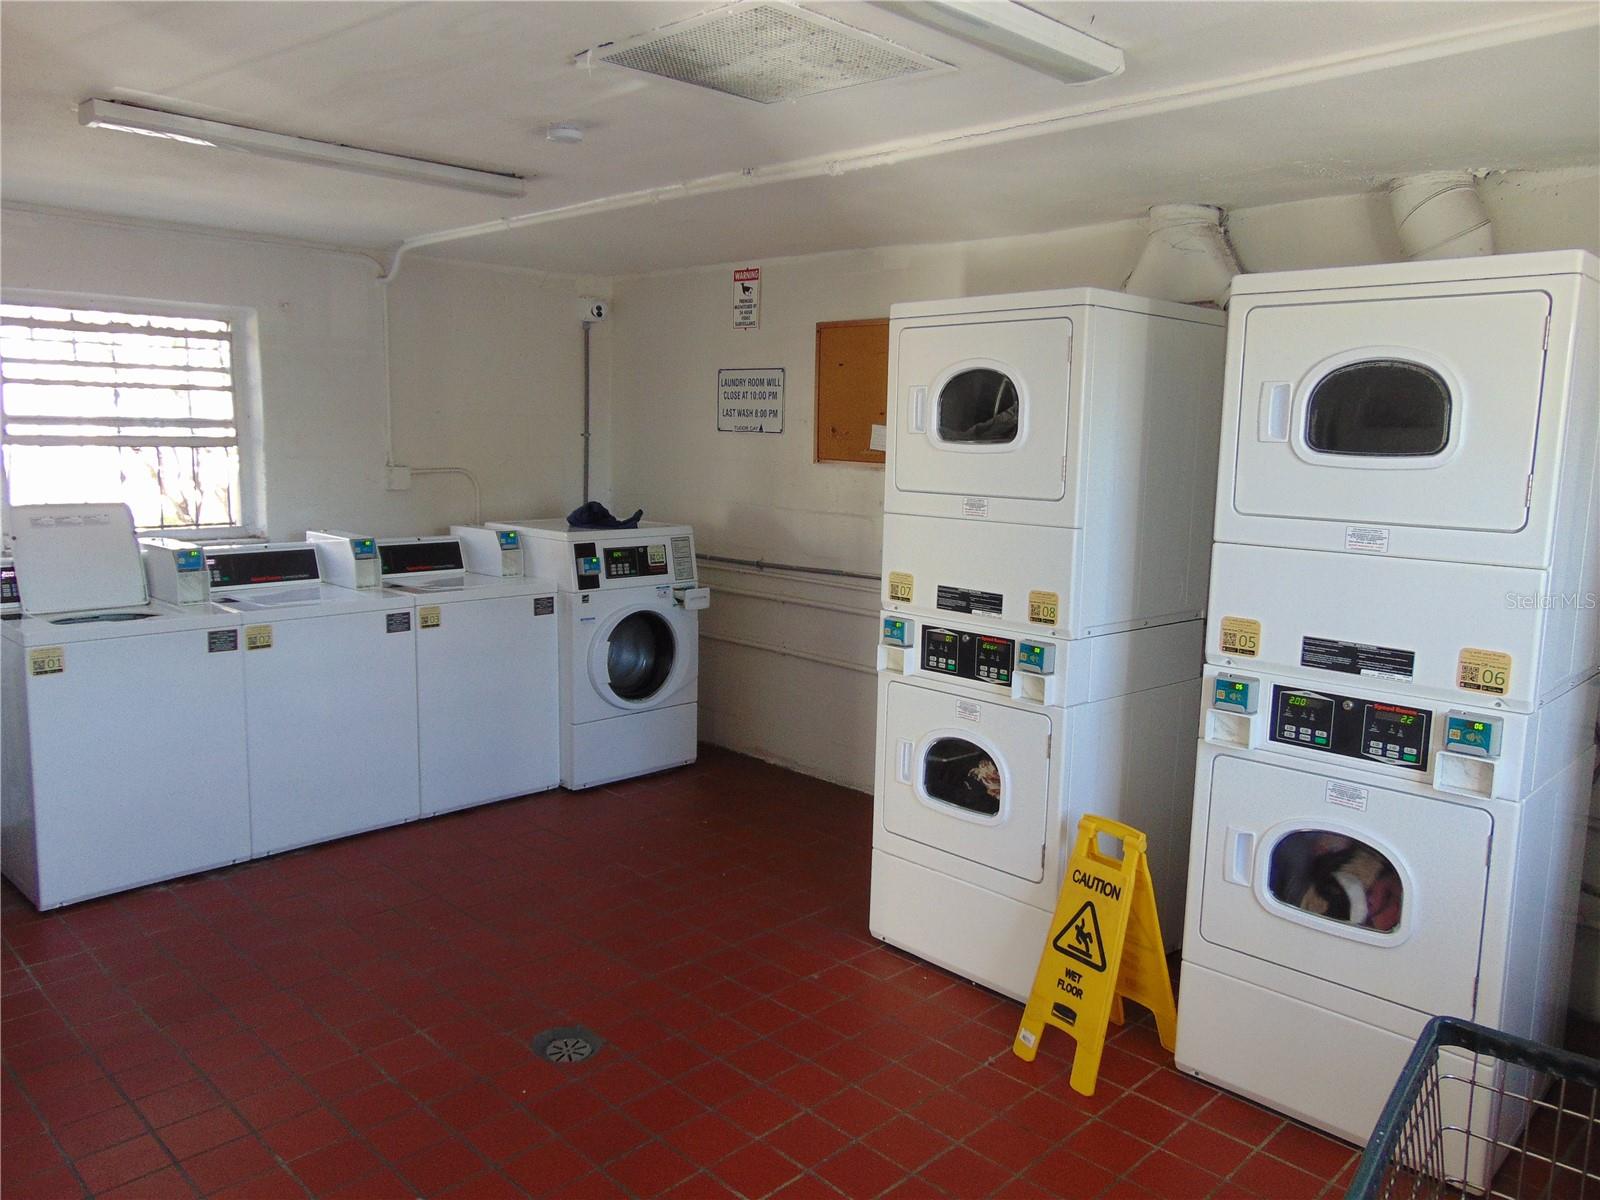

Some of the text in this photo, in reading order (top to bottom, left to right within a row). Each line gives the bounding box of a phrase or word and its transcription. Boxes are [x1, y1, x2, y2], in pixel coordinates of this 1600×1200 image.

[735, 270, 759, 281] WARNING
[721, 378, 782, 388] LAUNDRY ROOM WILL
[723, 391, 778, 400] CLOSE AT 10:00 PM
[722, 409, 778, 418] LAST WASH 8:00 PM
[900, 585, 911, 597] 07
[1042, 605, 1056, 618] 08
[1238, 635, 1256, 649] 05
[47, 658, 62, 669] 01
[1482, 669, 1505, 686] 06
[1289, 696, 1307, 706] 2.00
[1400, 715, 1414, 724] 22
[1072, 869, 1121, 901] CAUTION
[1065, 967, 1083, 984] WET
[1057, 978, 1083, 1000] FLOOR
